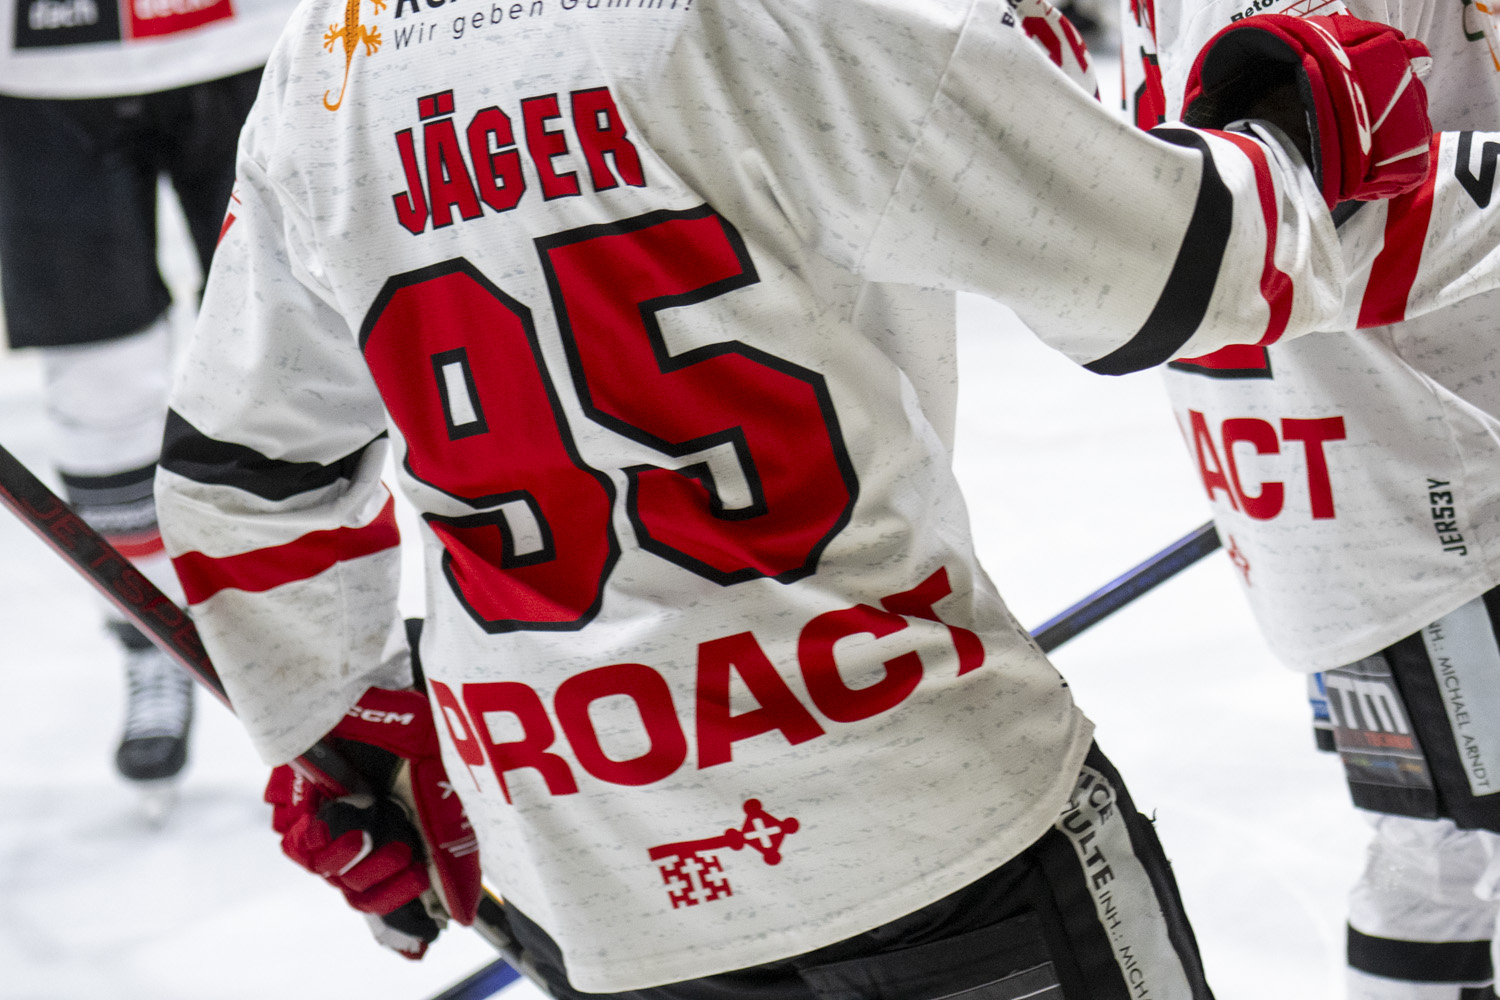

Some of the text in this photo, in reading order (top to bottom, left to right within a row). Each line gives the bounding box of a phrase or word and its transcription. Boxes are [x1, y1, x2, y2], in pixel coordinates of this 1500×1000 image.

[394, 24, 438, 50] Wir
[453, 0, 544, 41] geben
[392, 86, 648, 236] JÄGER
[358, 203, 859, 635] 95
[347, 705, 415, 725] CCM
[428, 565, 986, 806] PROACT
[1438, 657, 1470, 730] MICHAEL
[1462, 734, 1491, 788] ARNDT
[1119, 945, 1152, 1000] MICH
